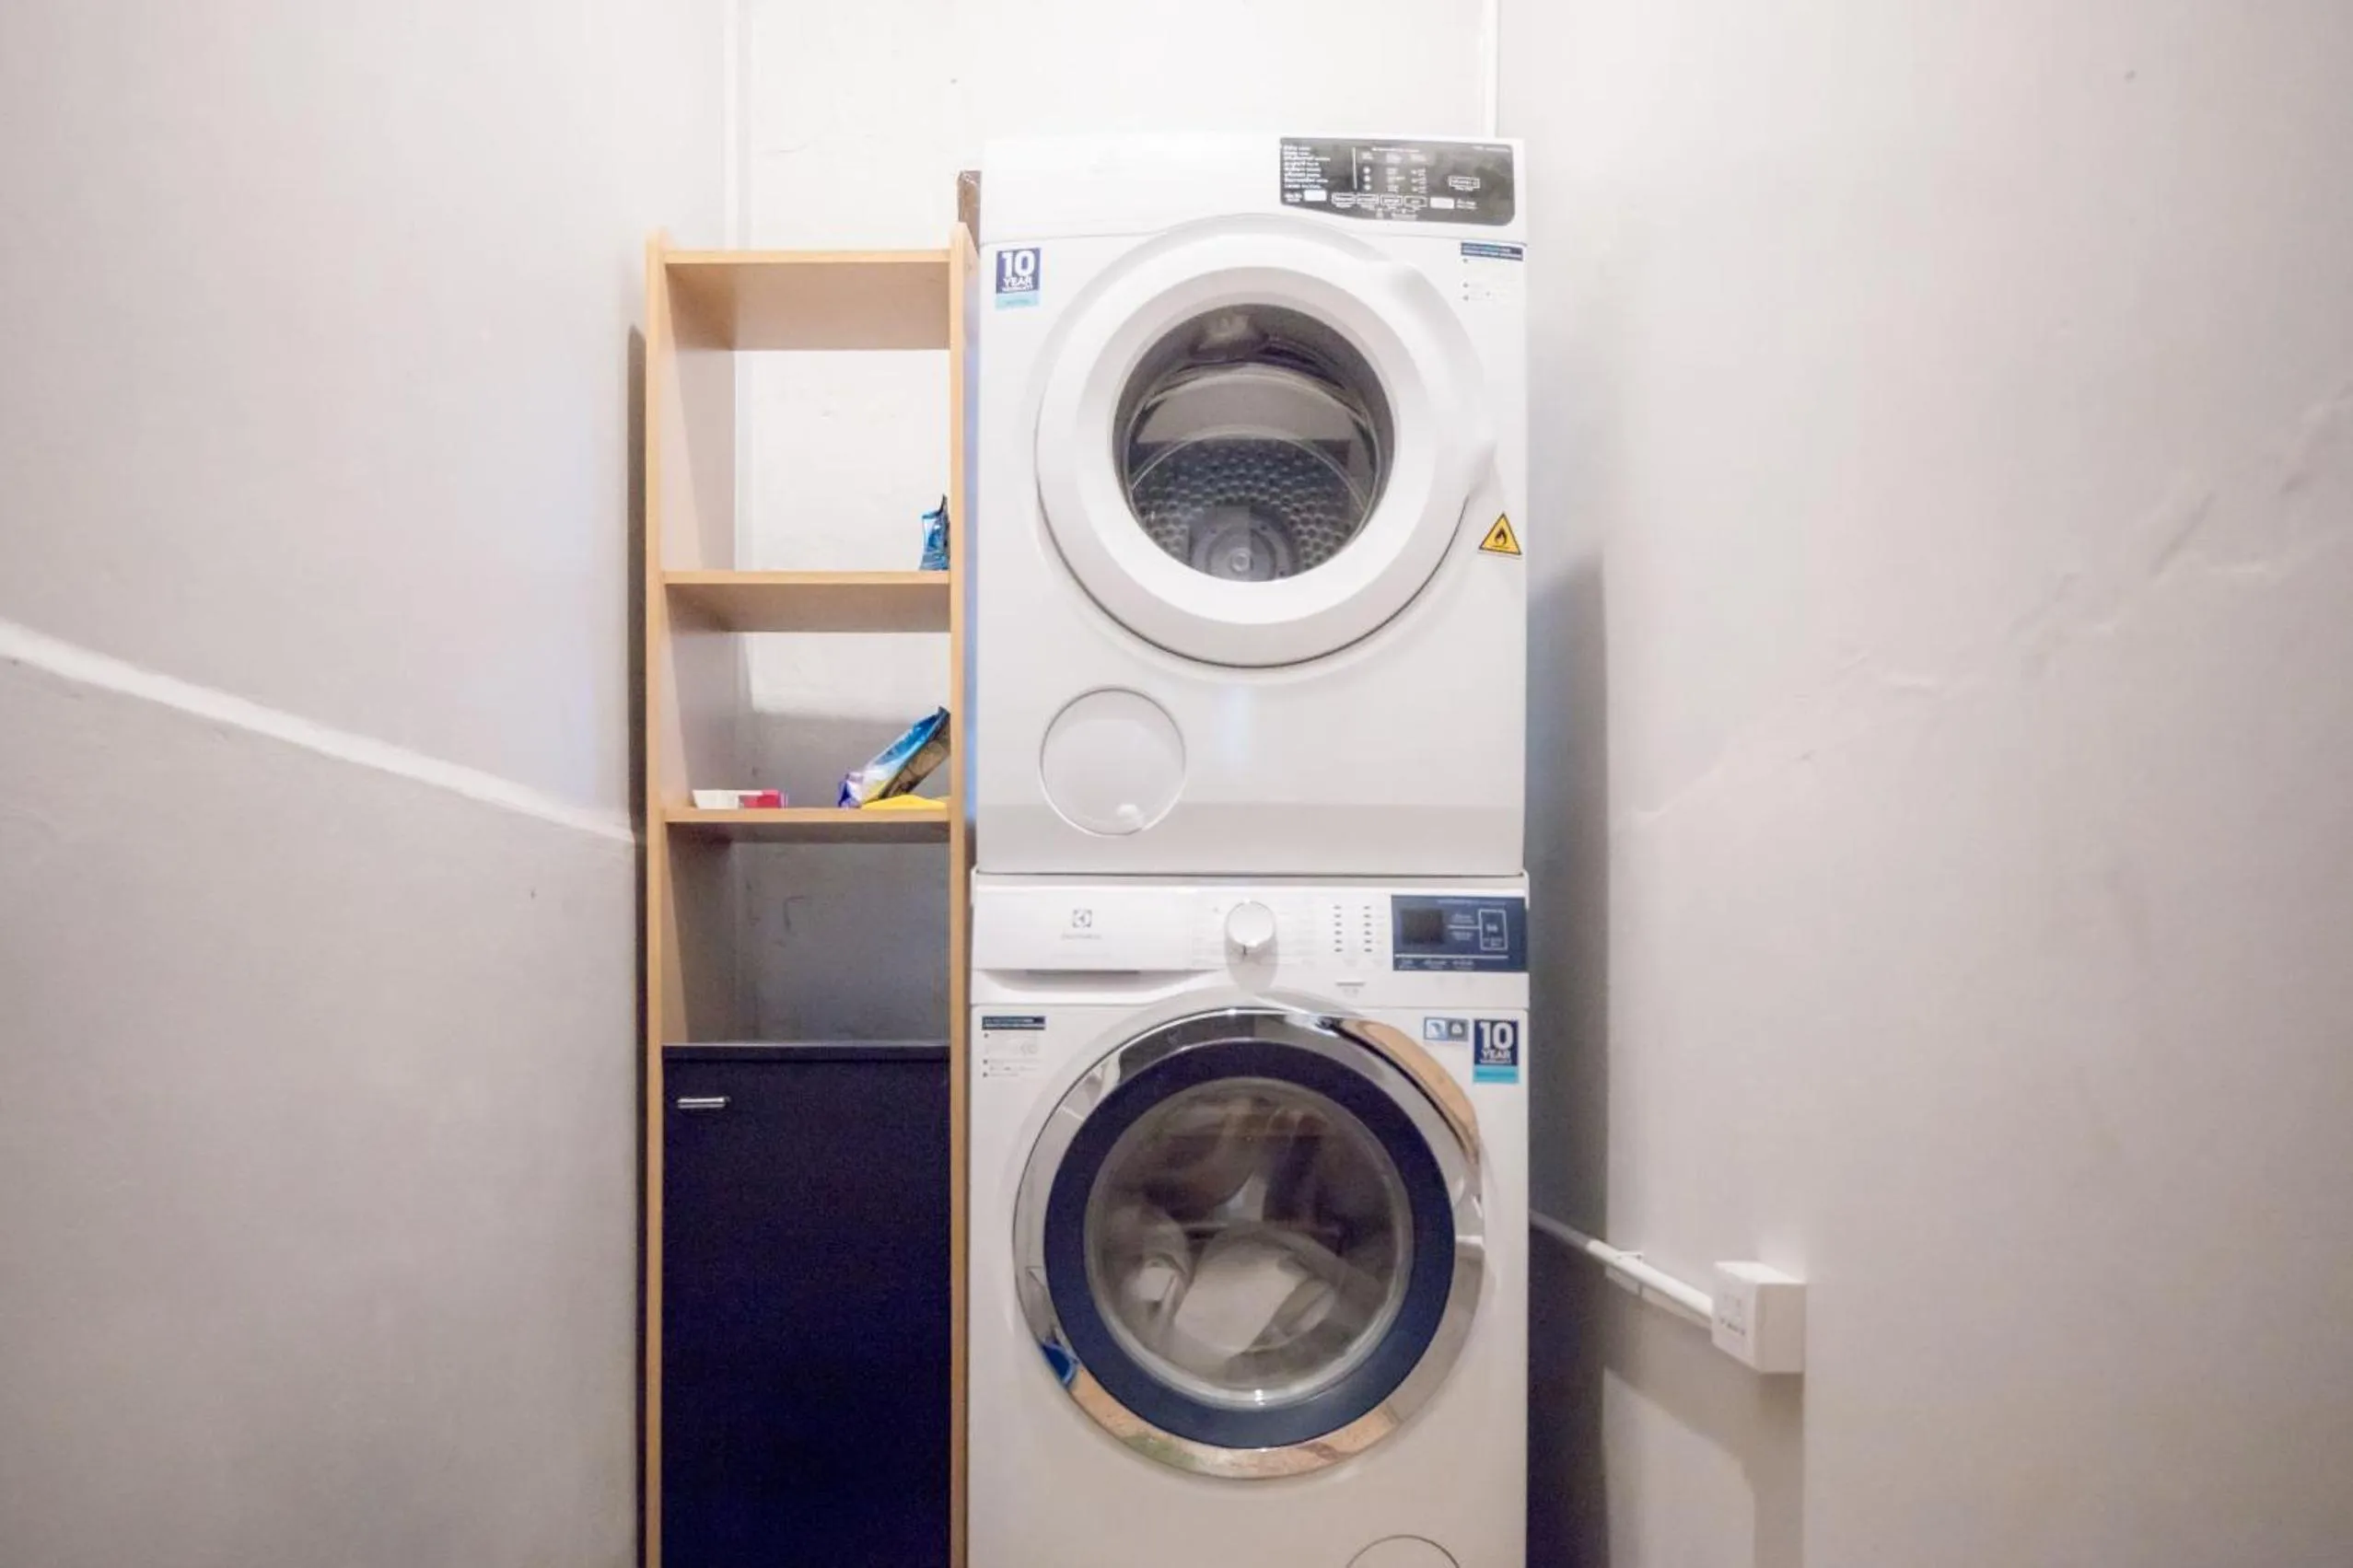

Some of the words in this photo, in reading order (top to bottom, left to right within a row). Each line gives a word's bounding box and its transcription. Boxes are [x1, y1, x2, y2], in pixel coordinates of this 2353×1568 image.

[1002, 250, 1034, 277] 10
[1003, 276, 1032, 287] YEAR
[1479, 1021, 1513, 1050] 10
[1482, 1050, 1511, 1059] YEAR
